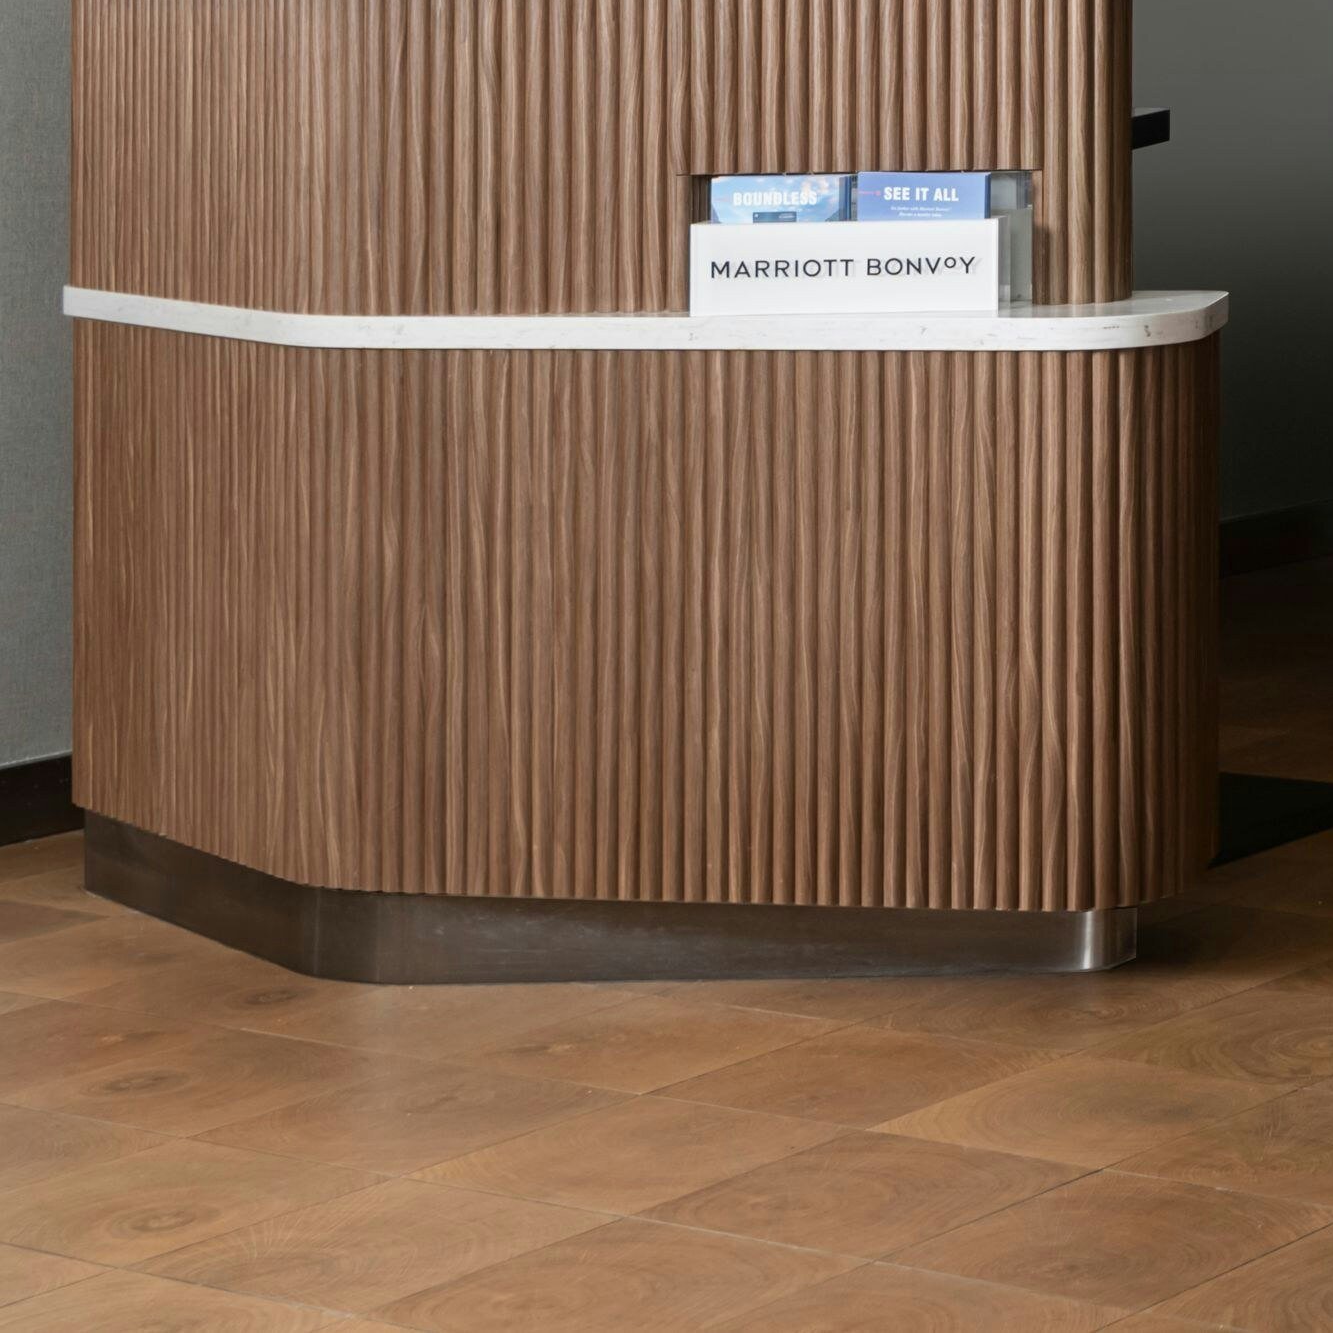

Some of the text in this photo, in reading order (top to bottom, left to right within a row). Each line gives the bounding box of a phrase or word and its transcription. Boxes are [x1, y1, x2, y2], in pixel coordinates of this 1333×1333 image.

[732, 190, 818, 207] BOUNDLESS
[883, 186, 959, 202] SEE IT ALL
[710, 255, 976, 279] MARRIOTT BONVOY
